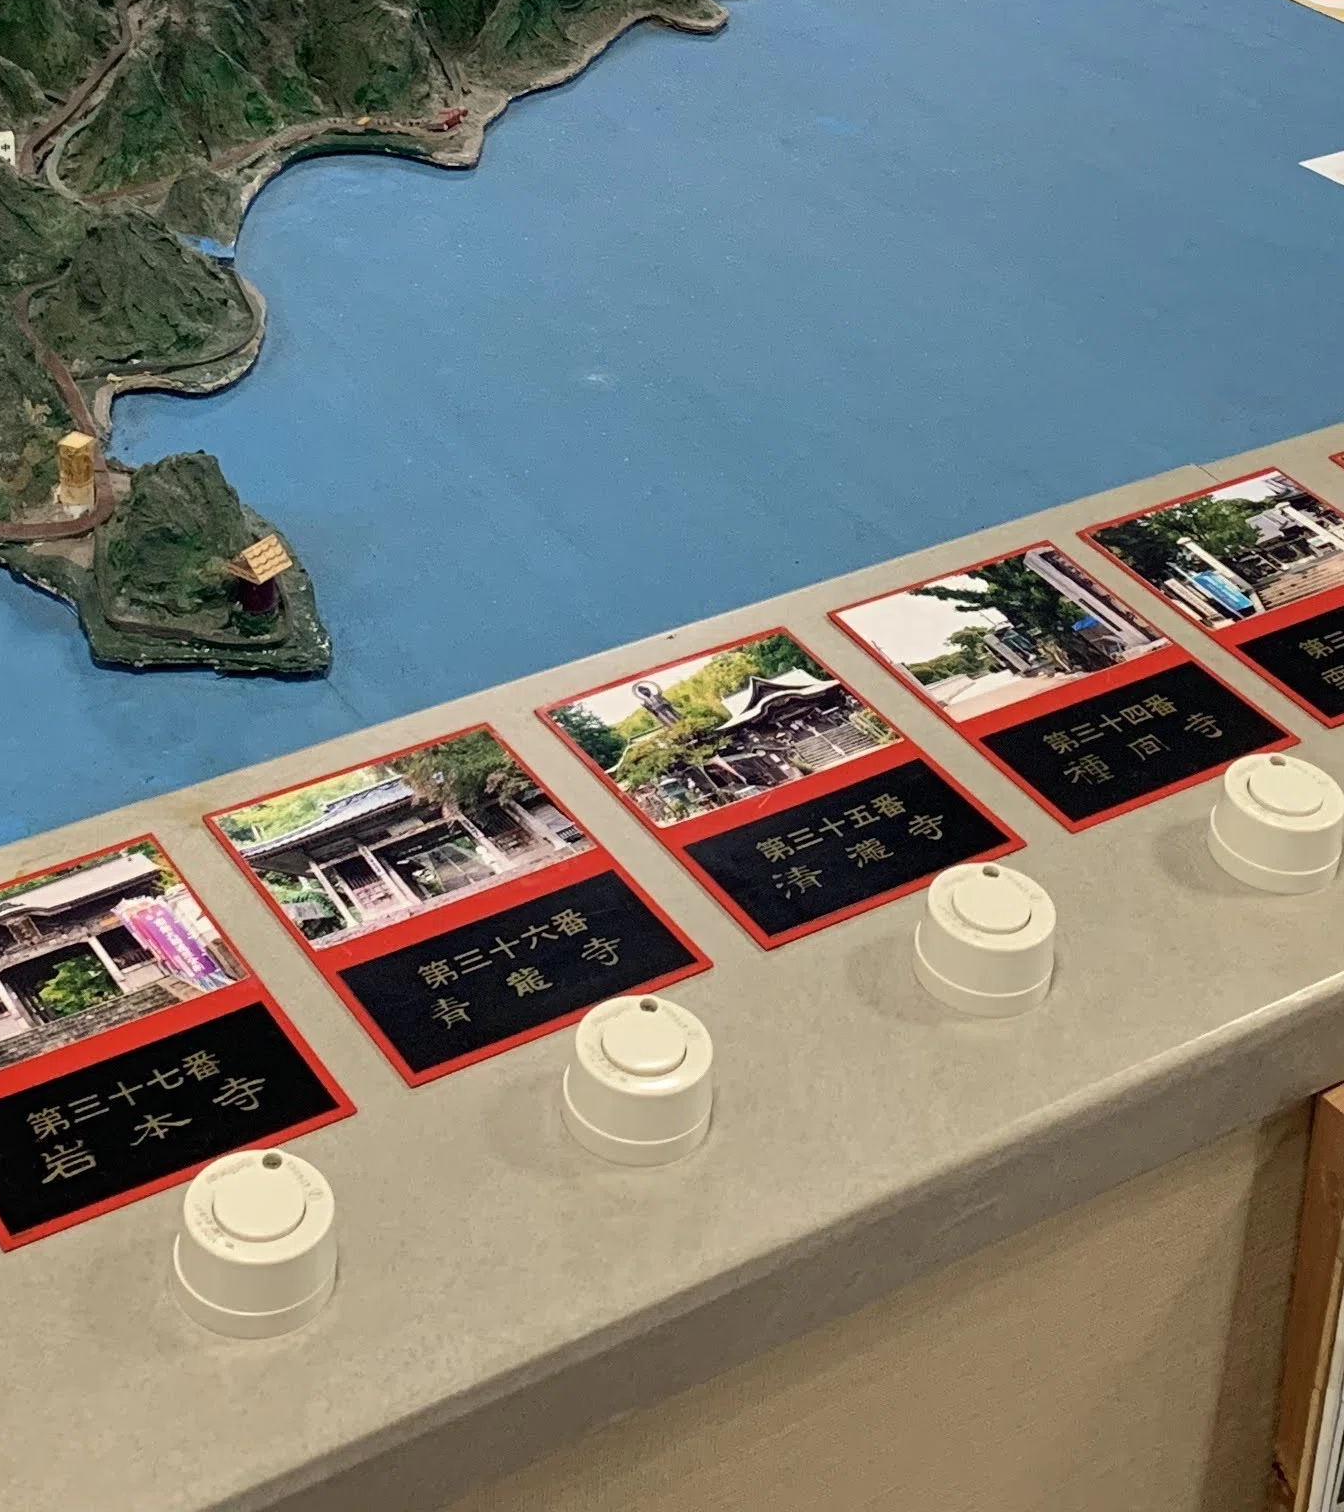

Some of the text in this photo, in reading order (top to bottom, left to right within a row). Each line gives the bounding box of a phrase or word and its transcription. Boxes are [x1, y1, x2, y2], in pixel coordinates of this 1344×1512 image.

[1042, 694, 1178, 755] 第三十四番
[1063, 712, 1223, 786] 種間寺
[756, 793, 906, 864] 第三十五番
[771, 814, 945, 900] 清瀧寺
[417, 908, 588, 990] 第三十六番
[26, 1049, 222, 1140] 第三十七番
[40, 1075, 266, 1186] 岩本寺
